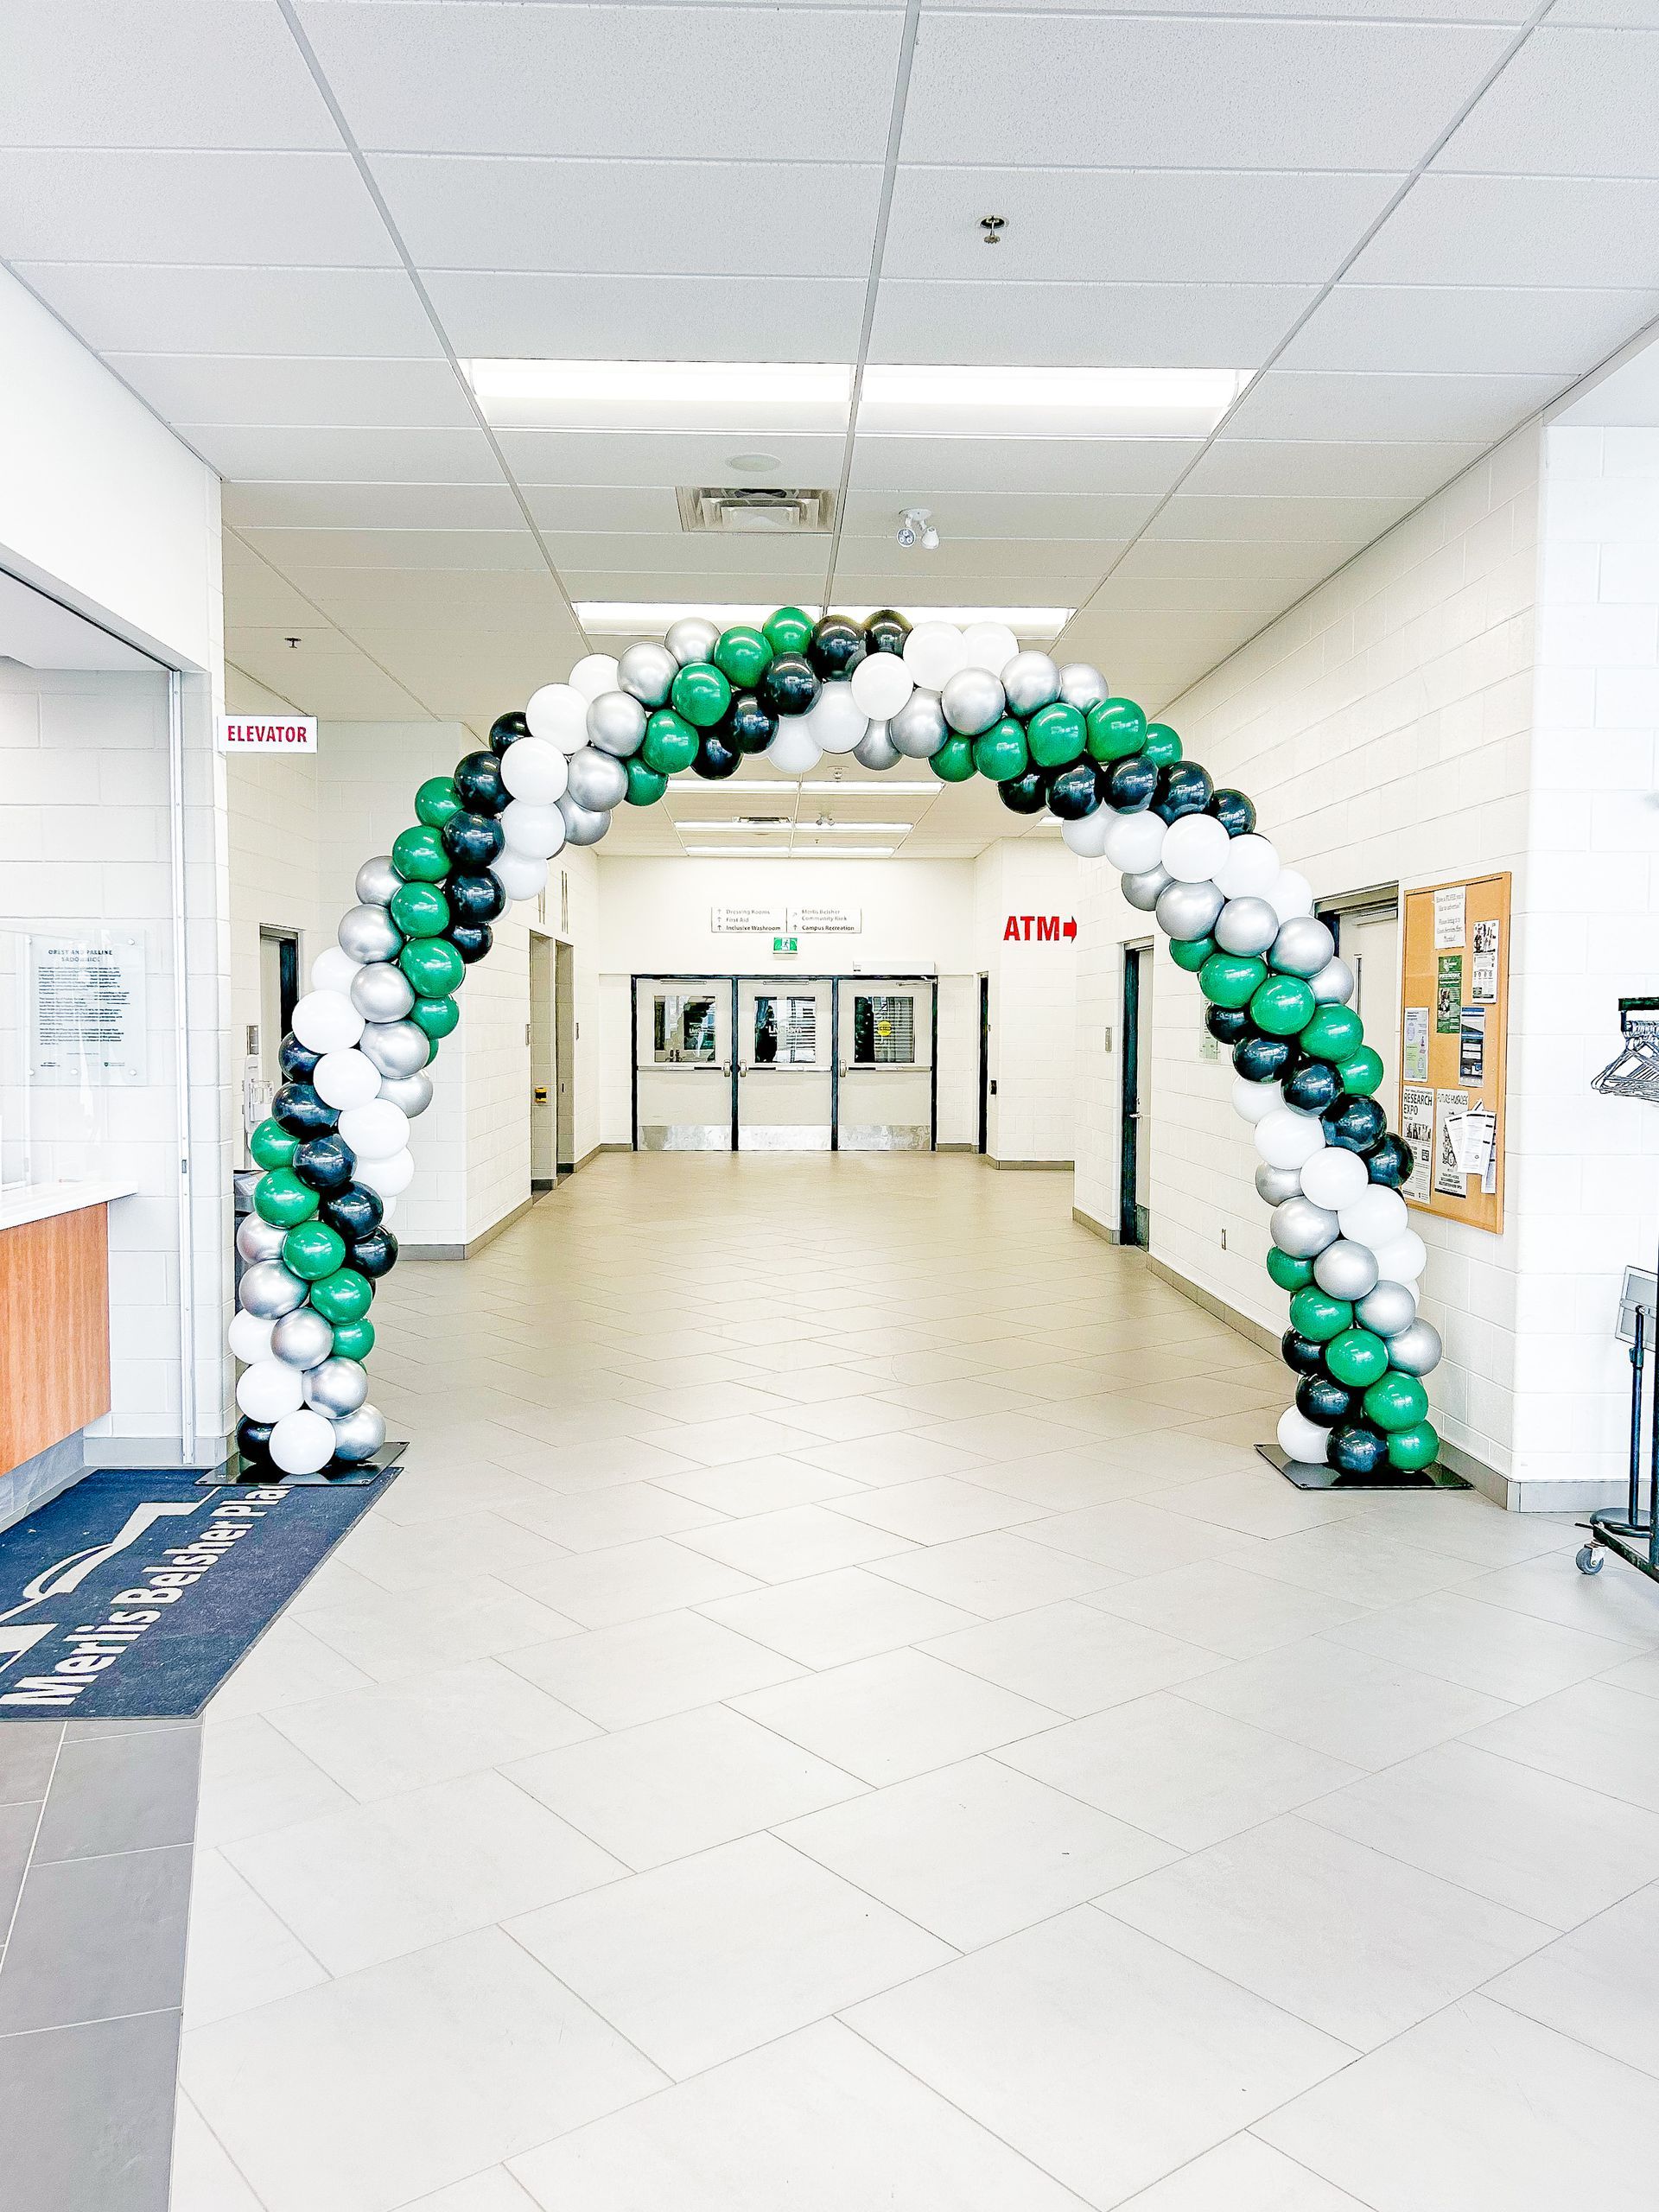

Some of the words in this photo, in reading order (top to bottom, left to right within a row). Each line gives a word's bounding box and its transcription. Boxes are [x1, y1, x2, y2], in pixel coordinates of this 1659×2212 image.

[227, 725, 307, 743] ELEVATOR
[1003, 916, 1059, 941] ATM
[1403, 1092, 1433, 1107] RESEARCH
[1403, 1103, 1419, 1116] EXPO
[0, 1609, 162, 1706] Merlis
[110, 1519, 254, 1605] Belsher
[209, 1484, 296, 1517] Pla
